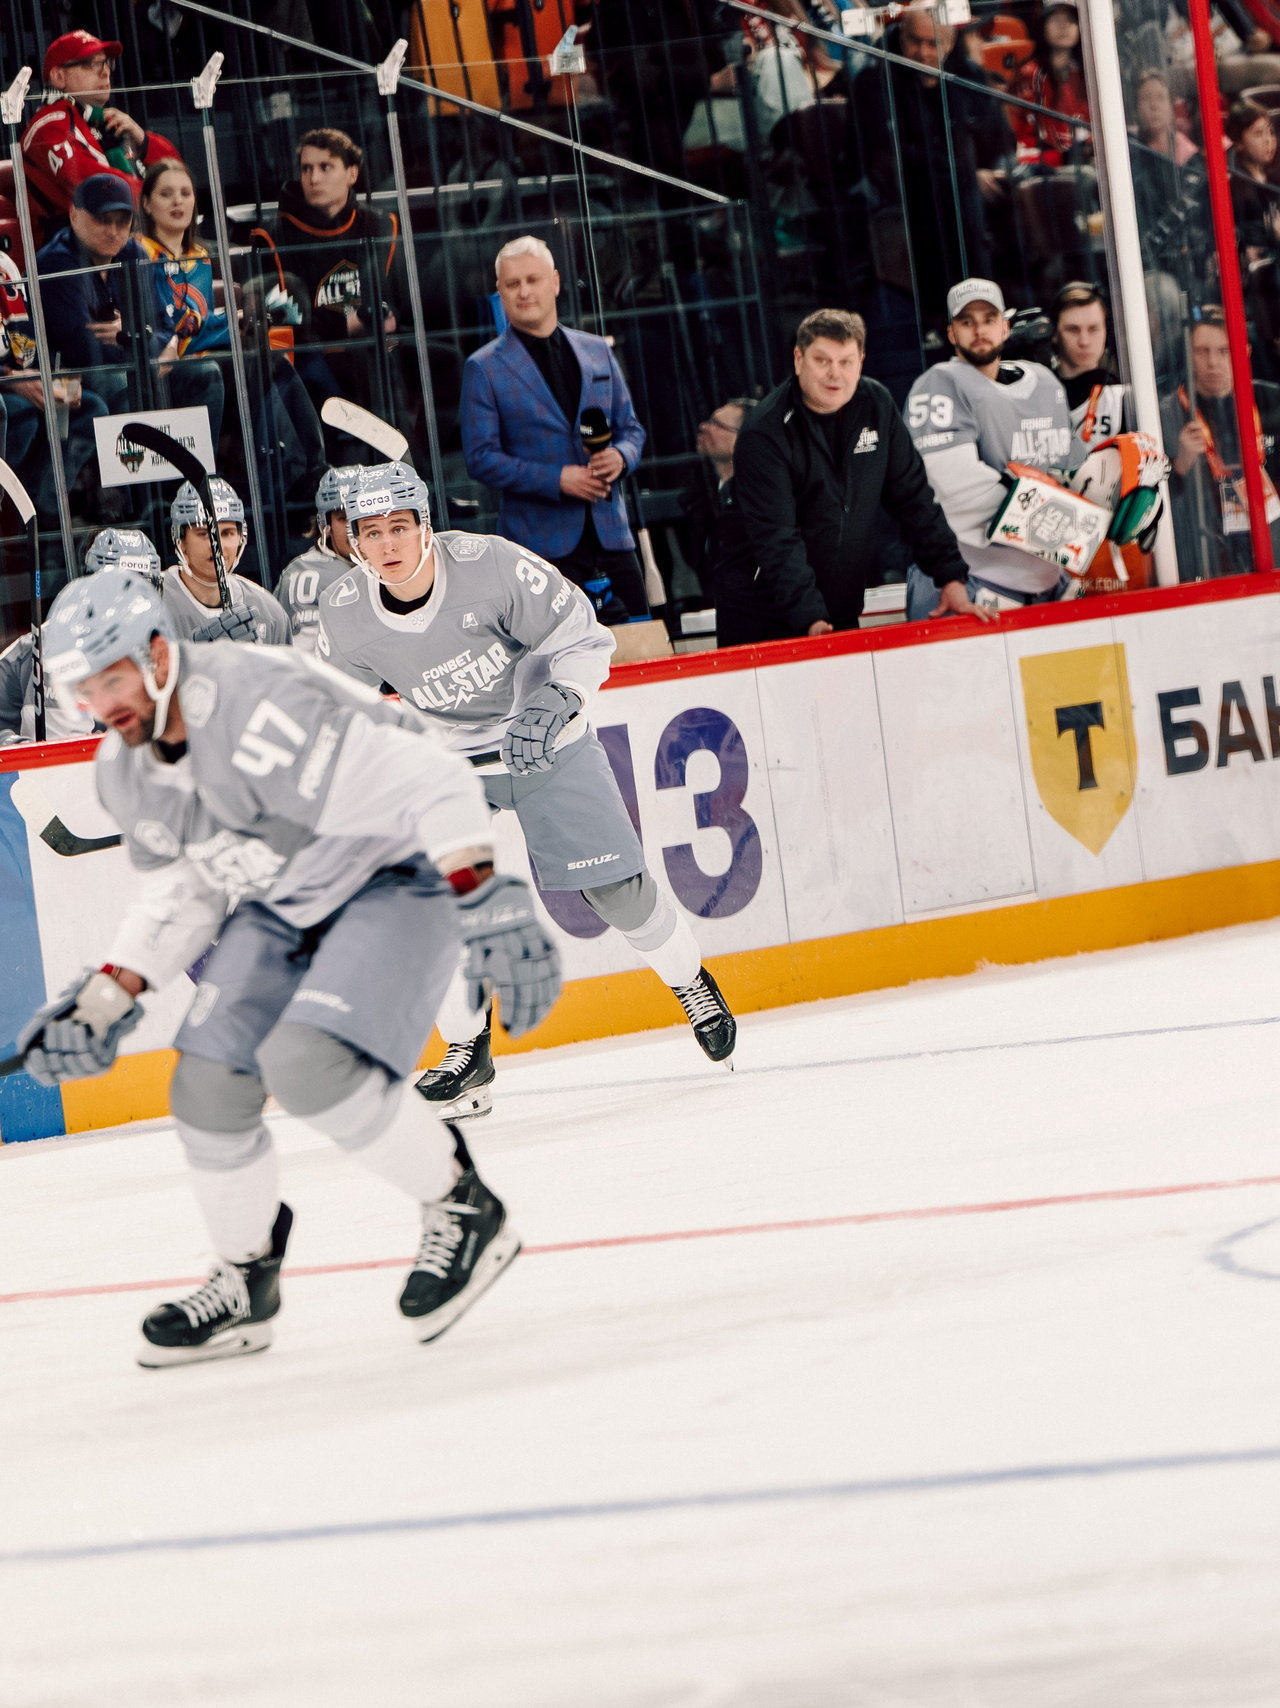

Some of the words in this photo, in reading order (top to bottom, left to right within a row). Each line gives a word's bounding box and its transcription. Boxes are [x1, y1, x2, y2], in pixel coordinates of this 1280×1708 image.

[47, 140, 74, 176] 47
[908, 393, 954, 428] 53
[359, 495, 391, 508] согаз
[288, 570, 320, 605] 10
[411, 682, 457, 710] ALL
[450, 642, 512, 693] STAR
[422, 649, 472, 684] FONBET
[231, 698, 308, 776] 47
[1054, 700, 1106, 791] Т
[567, 853, 612, 871] SOYUZ
